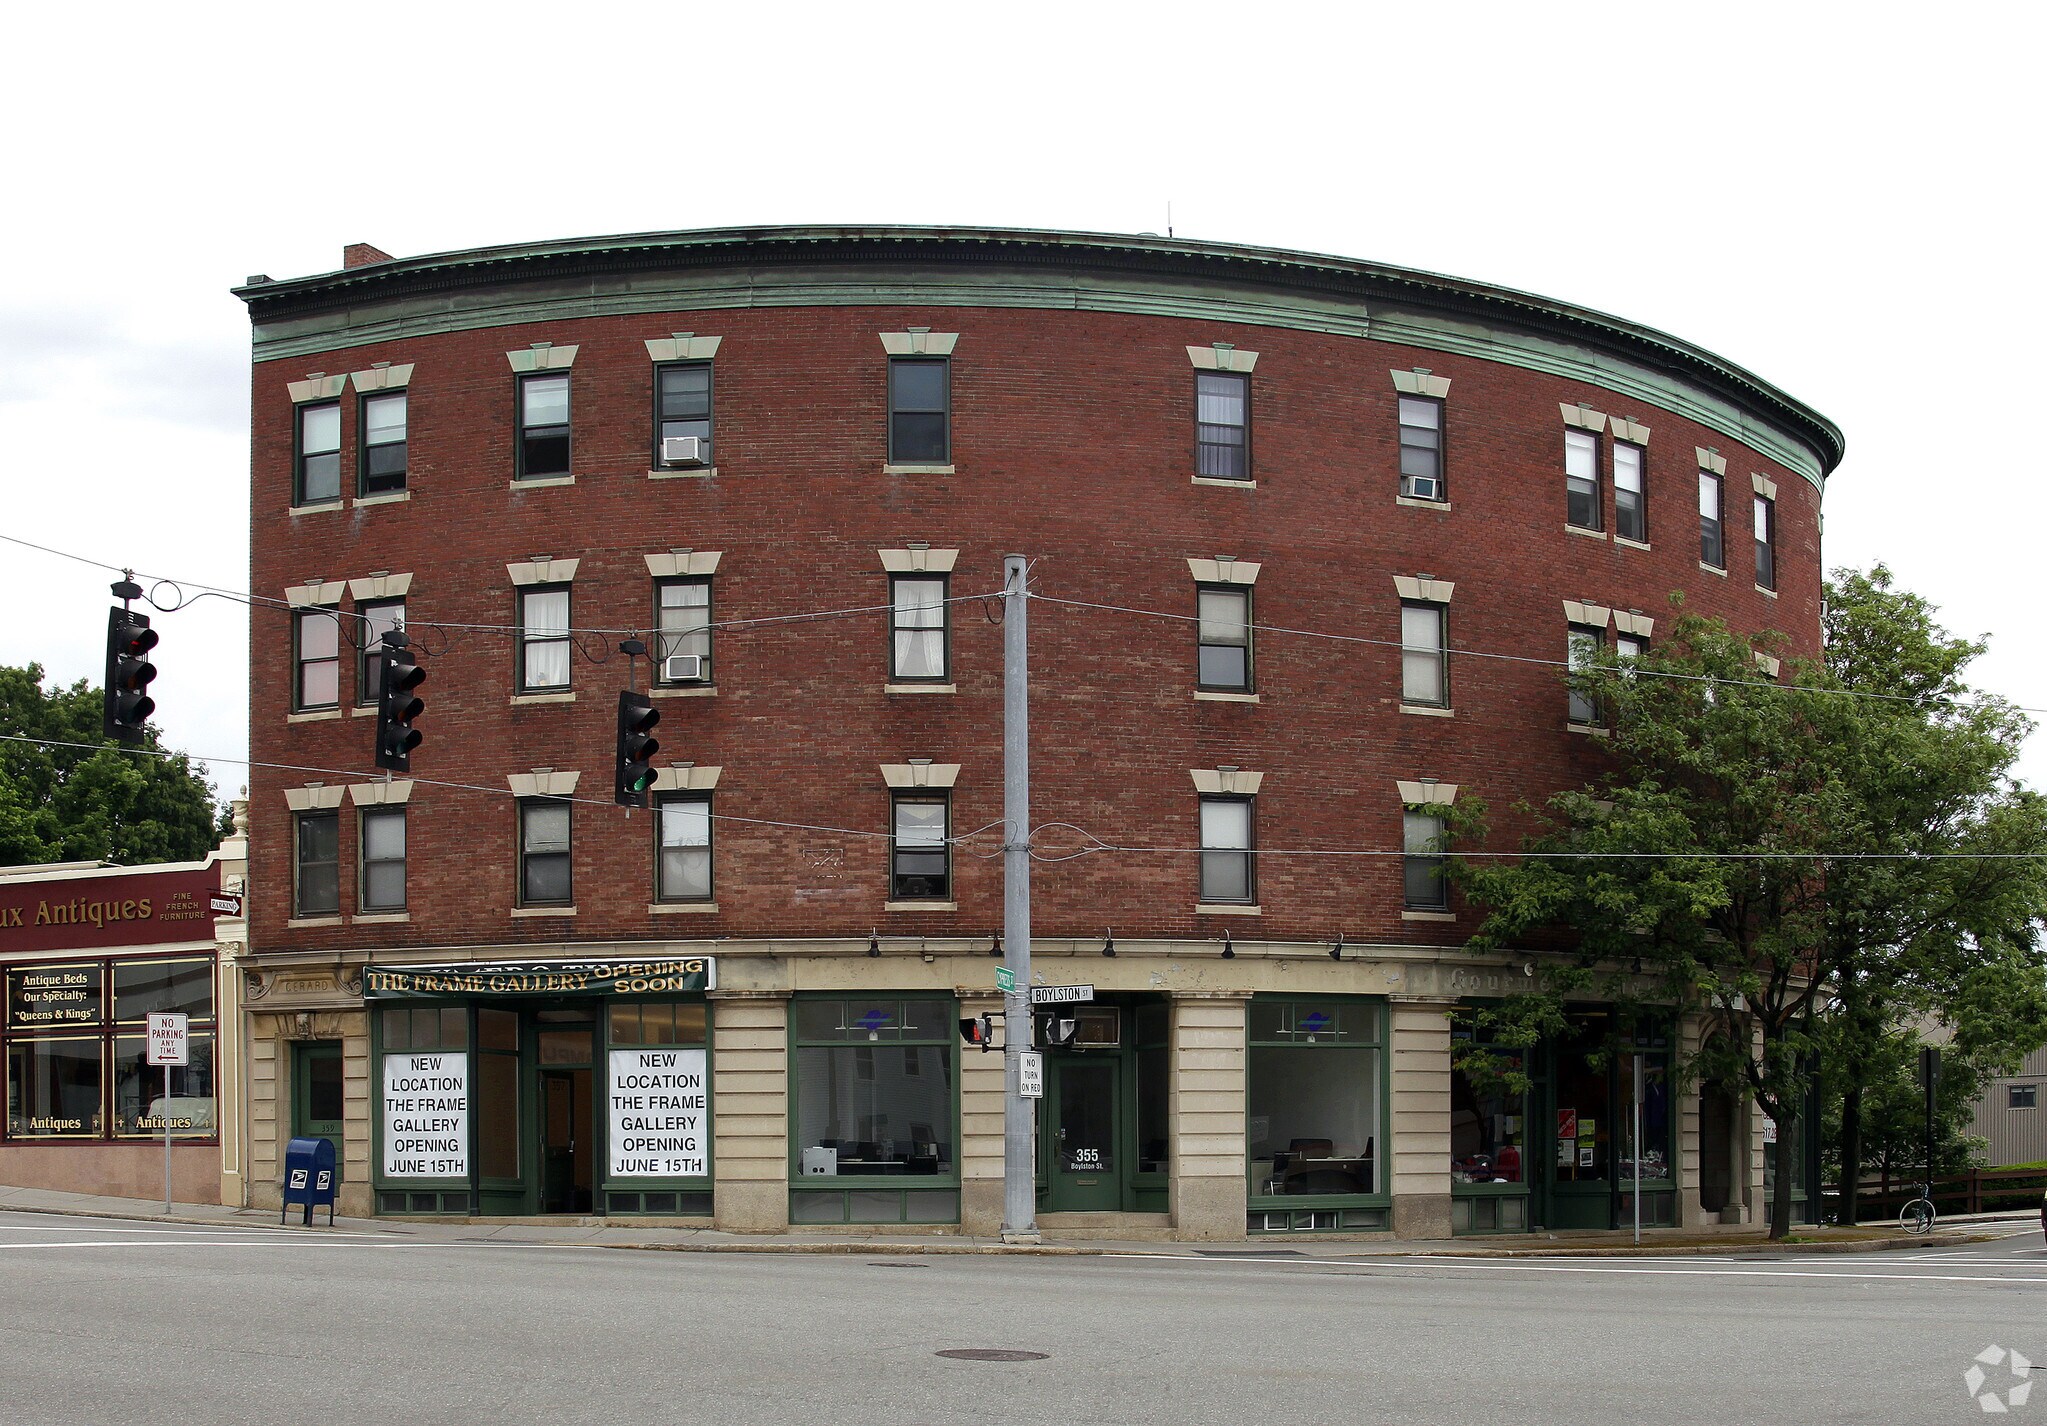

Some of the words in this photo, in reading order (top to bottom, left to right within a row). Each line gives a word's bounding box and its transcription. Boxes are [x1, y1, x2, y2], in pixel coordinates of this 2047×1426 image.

[166, 902, 199, 910] FRENCH
[211, 900, 237, 910] PARKING
[35, 898, 152, 928] Antiques
[160, 911, 205, 921] FURNITURE
[594, 959, 703, 979] OPENING
[23, 974, 61, 987] Antique
[64, 973, 88, 984] Beds
[367, 972, 410, 991] THE
[414, 973, 486, 992] FRAME
[489, 973, 589, 992] GALLERY
[614, 977, 684, 993] SOON
[24, 992, 40, 1002] Our
[42, 990, 87, 1003] Specialty:
[1035, 987, 1080, 1002] BOYLSTON
[15, 1011, 53, 1022] "Queens
[55, 1010, 64, 1019] &
[65, 1008, 96, 1021] Kings"
[161, 1018, 174, 1028] NO
[152, 1029, 184, 1040] PARKING
[160, 1047, 176, 1055] TIME
[411, 1057, 442, 1071] NEW
[639, 1053, 676, 1068] NEW
[1026, 1058, 1036, 1067] NO
[617, 1074, 700, 1089] LOCATION
[1024, 1070, 1039, 1080] TURN
[392, 1077, 463, 1092] LOCATION
[1021, 1083, 1030, 1092] ON
[1031, 1083, 1041, 1093] RED
[386, 1098, 414, 1112] THE
[418, 1097, 466, 1112] FRAME
[612, 1096, 643, 1110] THE
[649, 1095, 705, 1110] FRAME
[30, 1117, 82, 1132] Antiques
[321, 1124, 335, 1134] 359
[393, 1118, 459, 1132] GALLERY
[621, 1116, 697, 1131] GALLERY
[394, 1138, 459, 1153] OPENING
[623, 1137, 696, 1152] OPENING
[1076, 1148, 1099, 1162] 355
[389, 1159, 426, 1173] JUNE
[430, 1159, 464, 1173] 15TH
[616, 1158, 659, 1173] JUNE
[664, 1158, 702, 1172] 15TH
